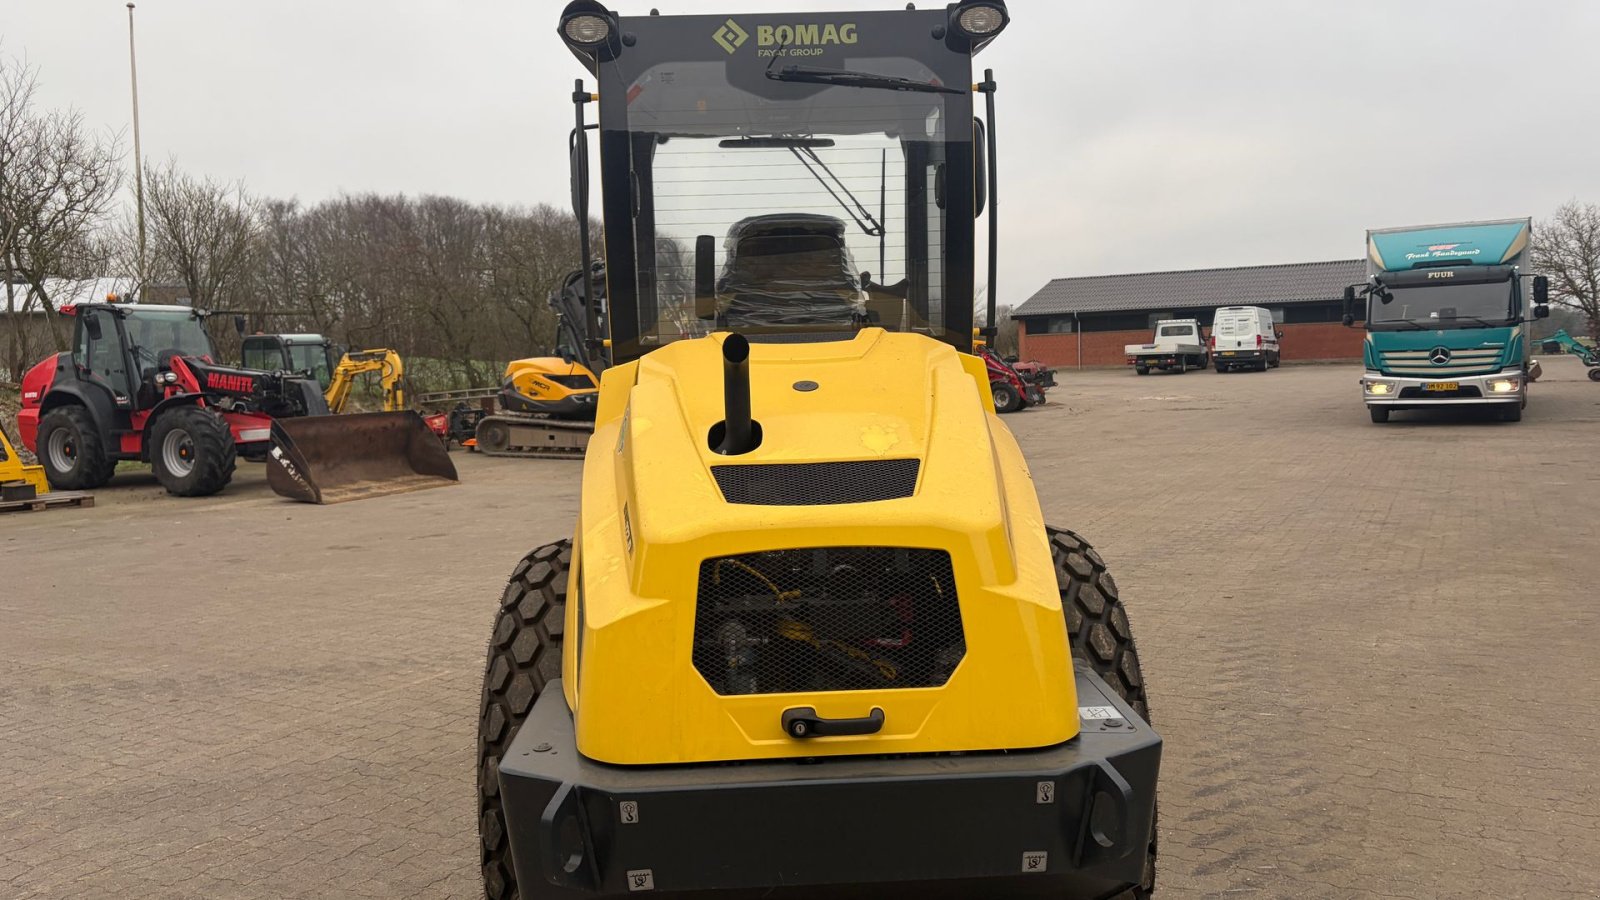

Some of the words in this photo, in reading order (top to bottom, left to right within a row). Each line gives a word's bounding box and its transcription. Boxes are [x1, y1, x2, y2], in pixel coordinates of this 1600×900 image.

[757, 24, 858, 46] BOMAG
[758, 48, 787, 57] FAYAT
[789, 48, 824, 56] GROUP
